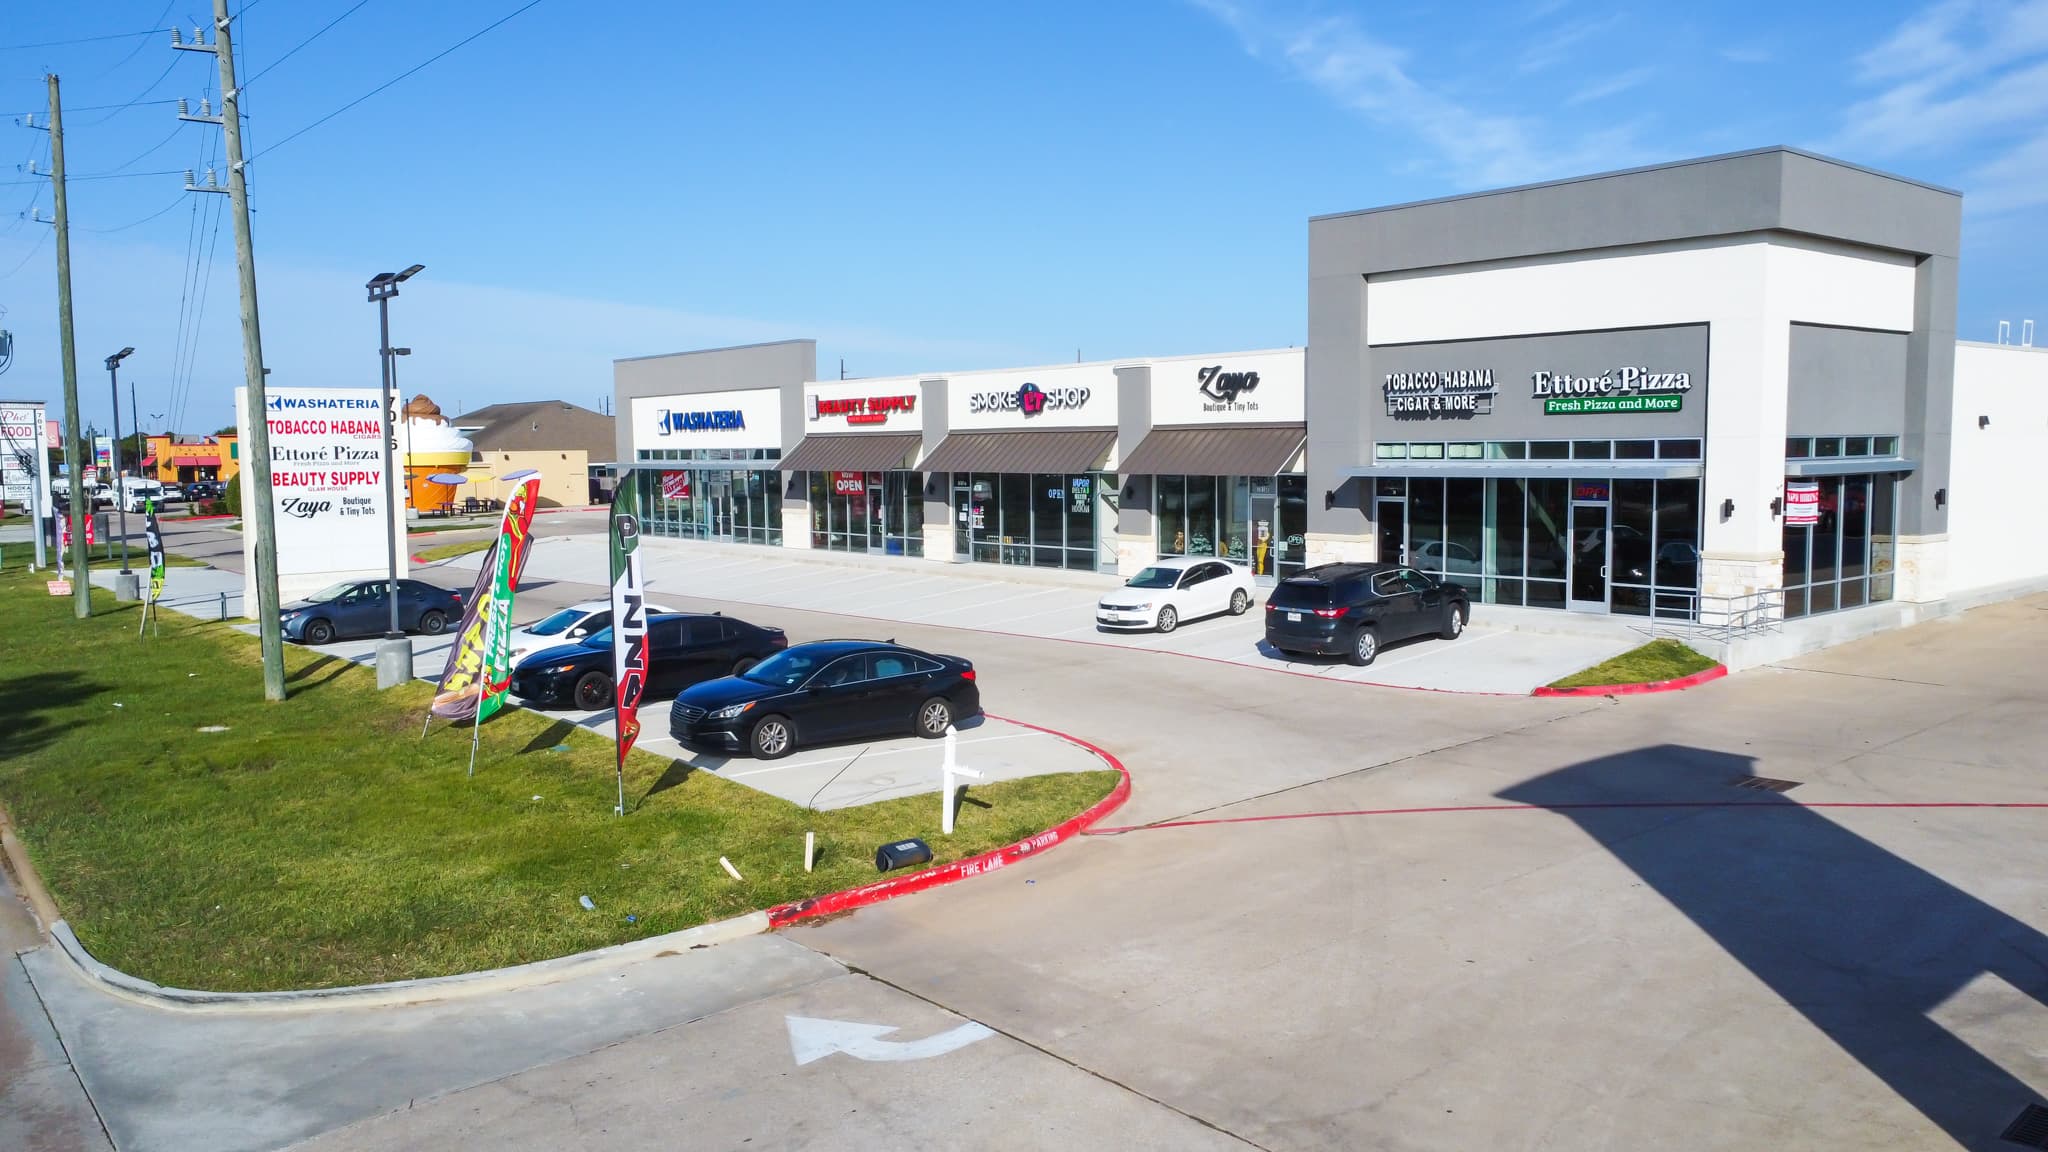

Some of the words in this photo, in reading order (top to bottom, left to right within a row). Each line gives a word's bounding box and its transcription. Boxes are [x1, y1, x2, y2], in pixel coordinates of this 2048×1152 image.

[1198, 365, 1260, 402] Zaya
[1386, 372, 1437, 390] TOBACCO
[1445, 369, 1492, 388] HABANA
[1534, 370, 1612, 395] Ettoré
[1620, 367, 1691, 391] Pizza
[284, 398, 380, 409] WASHATERIA
[818, 398, 866, 414] BEAUTY
[868, 395, 915, 411] SUPPLY
[970, 391, 1017, 410] SMOKE
[1047, 387, 1089, 406] SHOP
[1234, 402, 1245, 412] Tiny
[1247, 402, 1259, 411] Tots
[1397, 396, 1429, 411] CIGAR
[1434, 396, 1440, 410] &
[1445, 395, 1476, 411] MORE
[1549, 401, 1581, 411] Fresh
[1583, 400, 1615, 410] Pizza
[1619, 399, 1642, 409] and
[1645, 399, 1678, 409] More
[267, 420, 327, 434] TOBACCO
[331, 420, 381, 434] HABANA
[672, 410, 745, 431] WASHATERIA
[1, 426, 32, 437] FOOD
[271, 446, 328, 461] Ettoré
[334, 445, 379, 460] Pizza
[272, 472, 326, 486] BEAUTY
[331, 471, 380, 485] SUPPLY
[836, 480, 862, 491] OPEN
[281, 497, 332, 518] Zaya
[342, 497, 371, 507] Boutique
[340, 507, 344, 515] &
[346, 507, 360, 516] Tiny
[362, 507, 375, 515] Tots
[498, 538, 508, 577] HOT
[615, 513, 643, 708] PIZZA
[494, 599, 510, 672] PIZZA
[1031, 831, 1059, 849] PARKING
[961, 862, 980, 877] FIRE
[983, 855, 1003, 872] LANE
